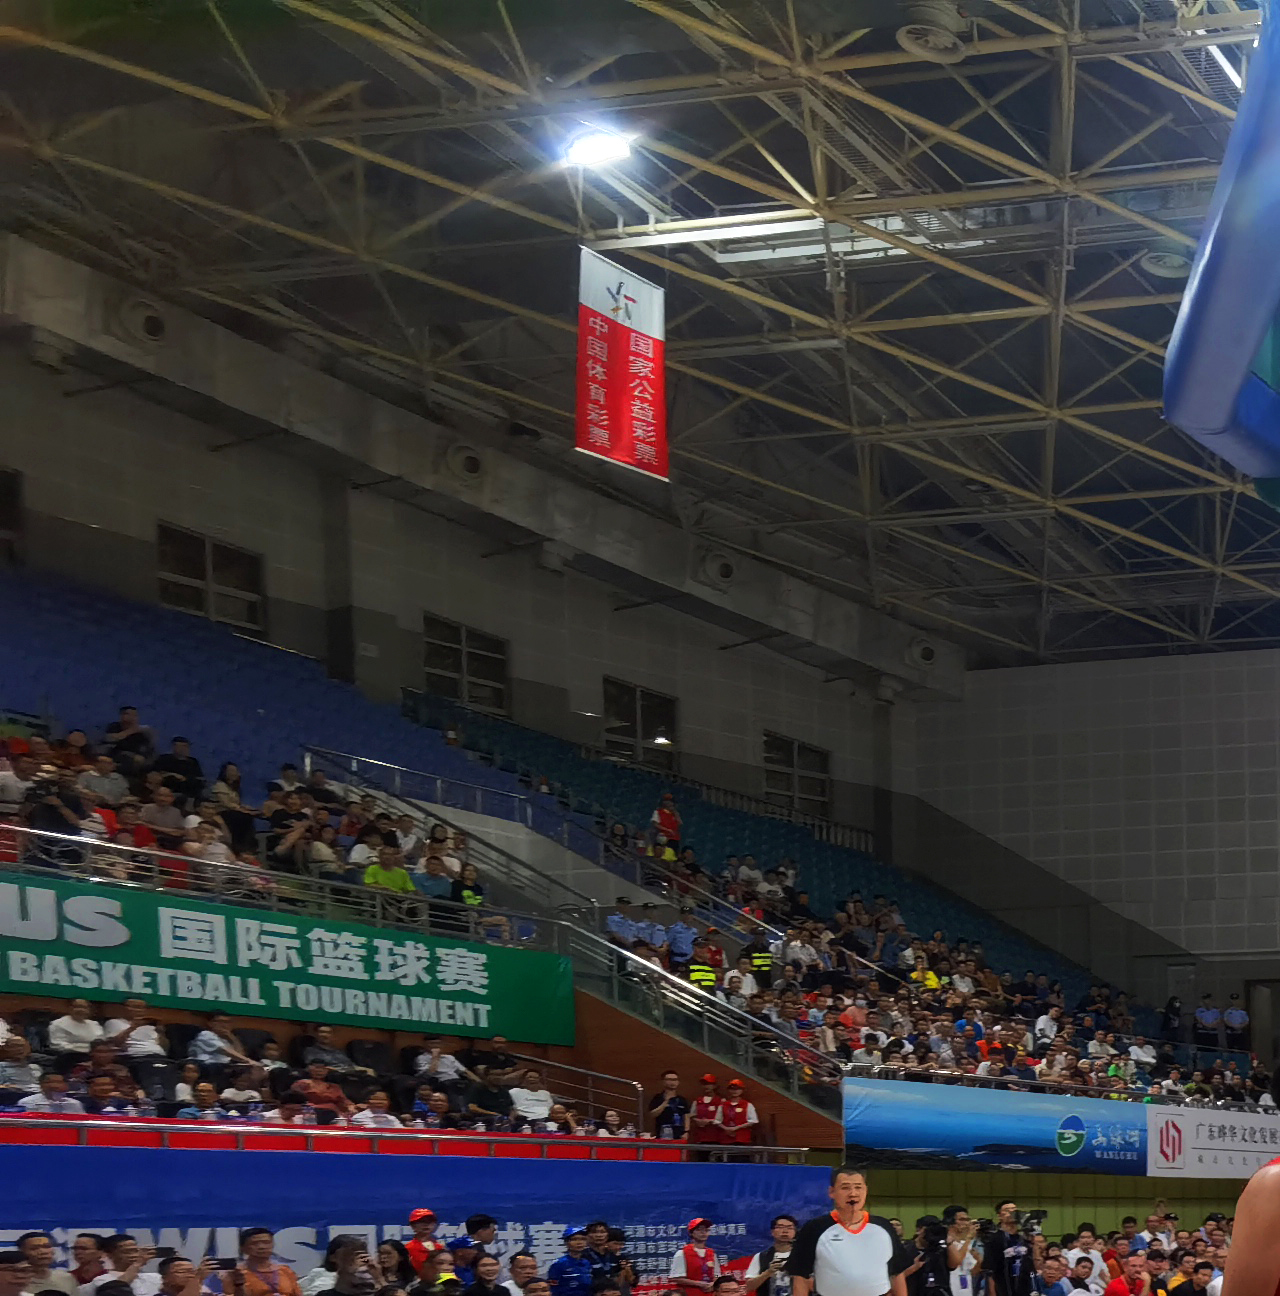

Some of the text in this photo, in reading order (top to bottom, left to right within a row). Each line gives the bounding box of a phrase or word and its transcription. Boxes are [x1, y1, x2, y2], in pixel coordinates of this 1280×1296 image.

[8, 950, 491, 1028] BASKETBALL TOURNAMENT
[158, 906, 490, 995] 国际篮球赛
